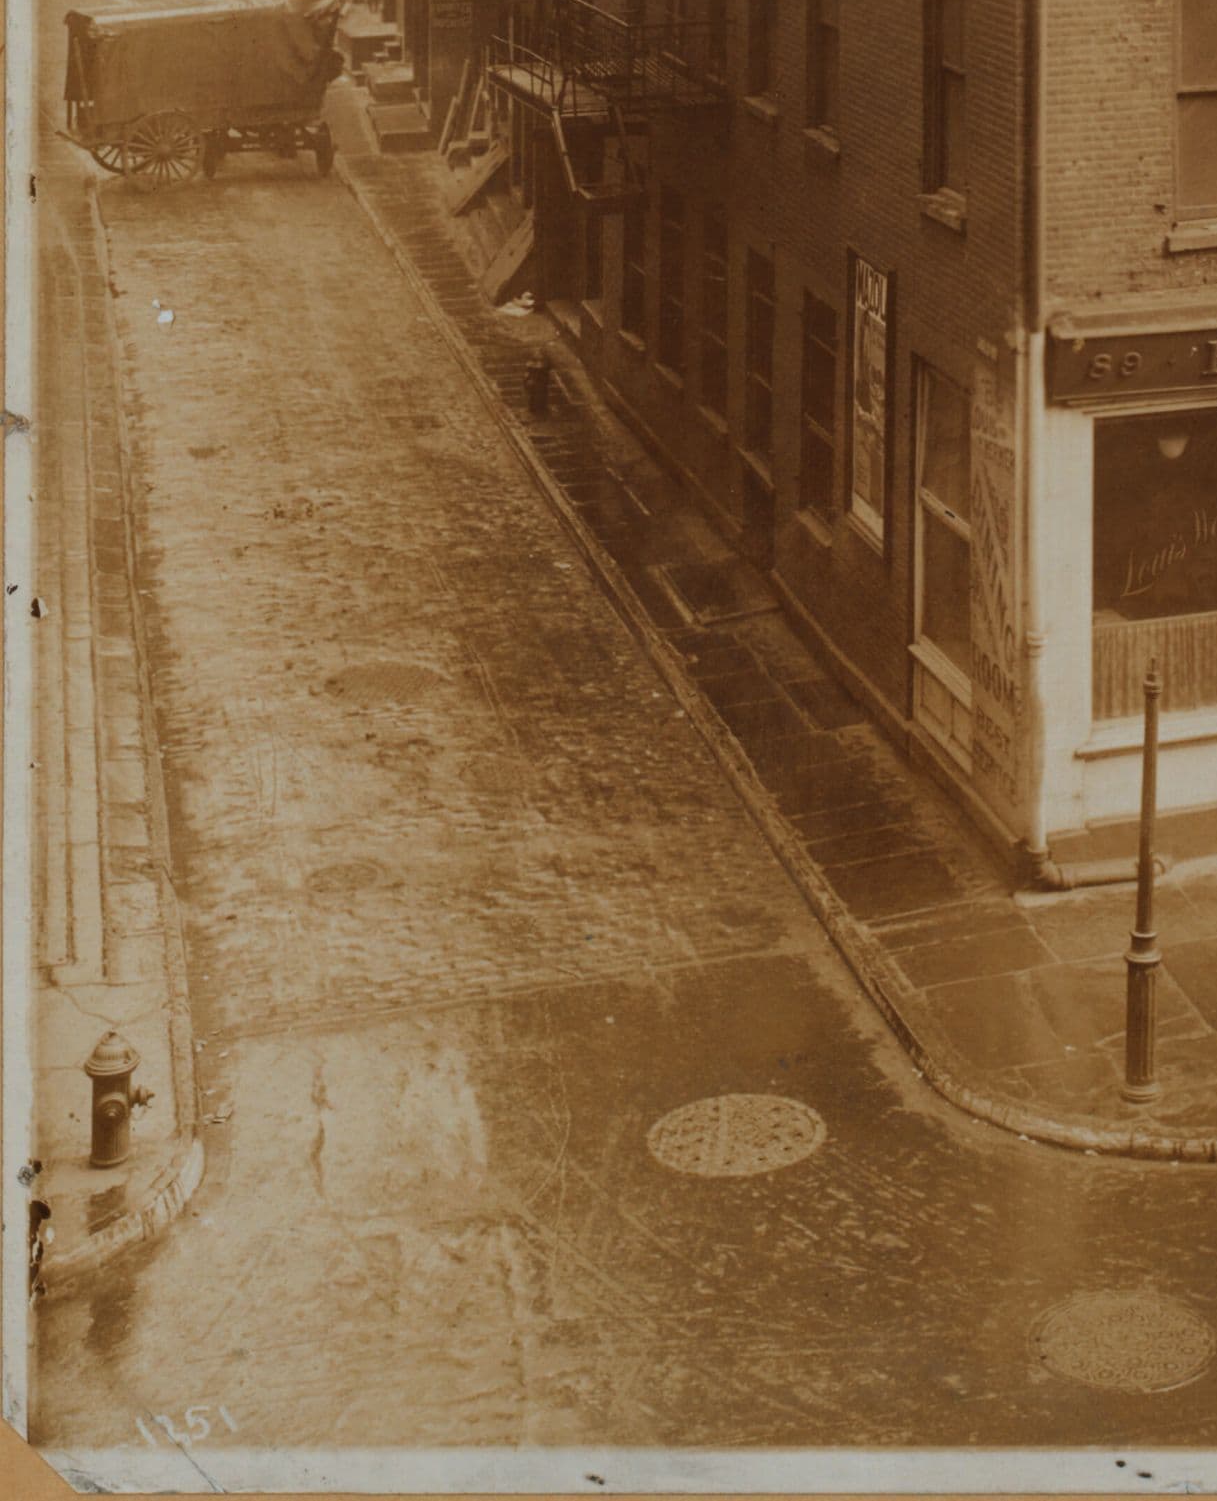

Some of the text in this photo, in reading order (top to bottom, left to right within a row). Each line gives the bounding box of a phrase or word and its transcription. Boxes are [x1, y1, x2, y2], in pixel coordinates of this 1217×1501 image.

[855, 258, 888, 322] MAZOL
[1086, 349, 1144, 379] 89
[1119, 530, 1187, 597] Louis
[976, 705, 1011, 755] BEST
